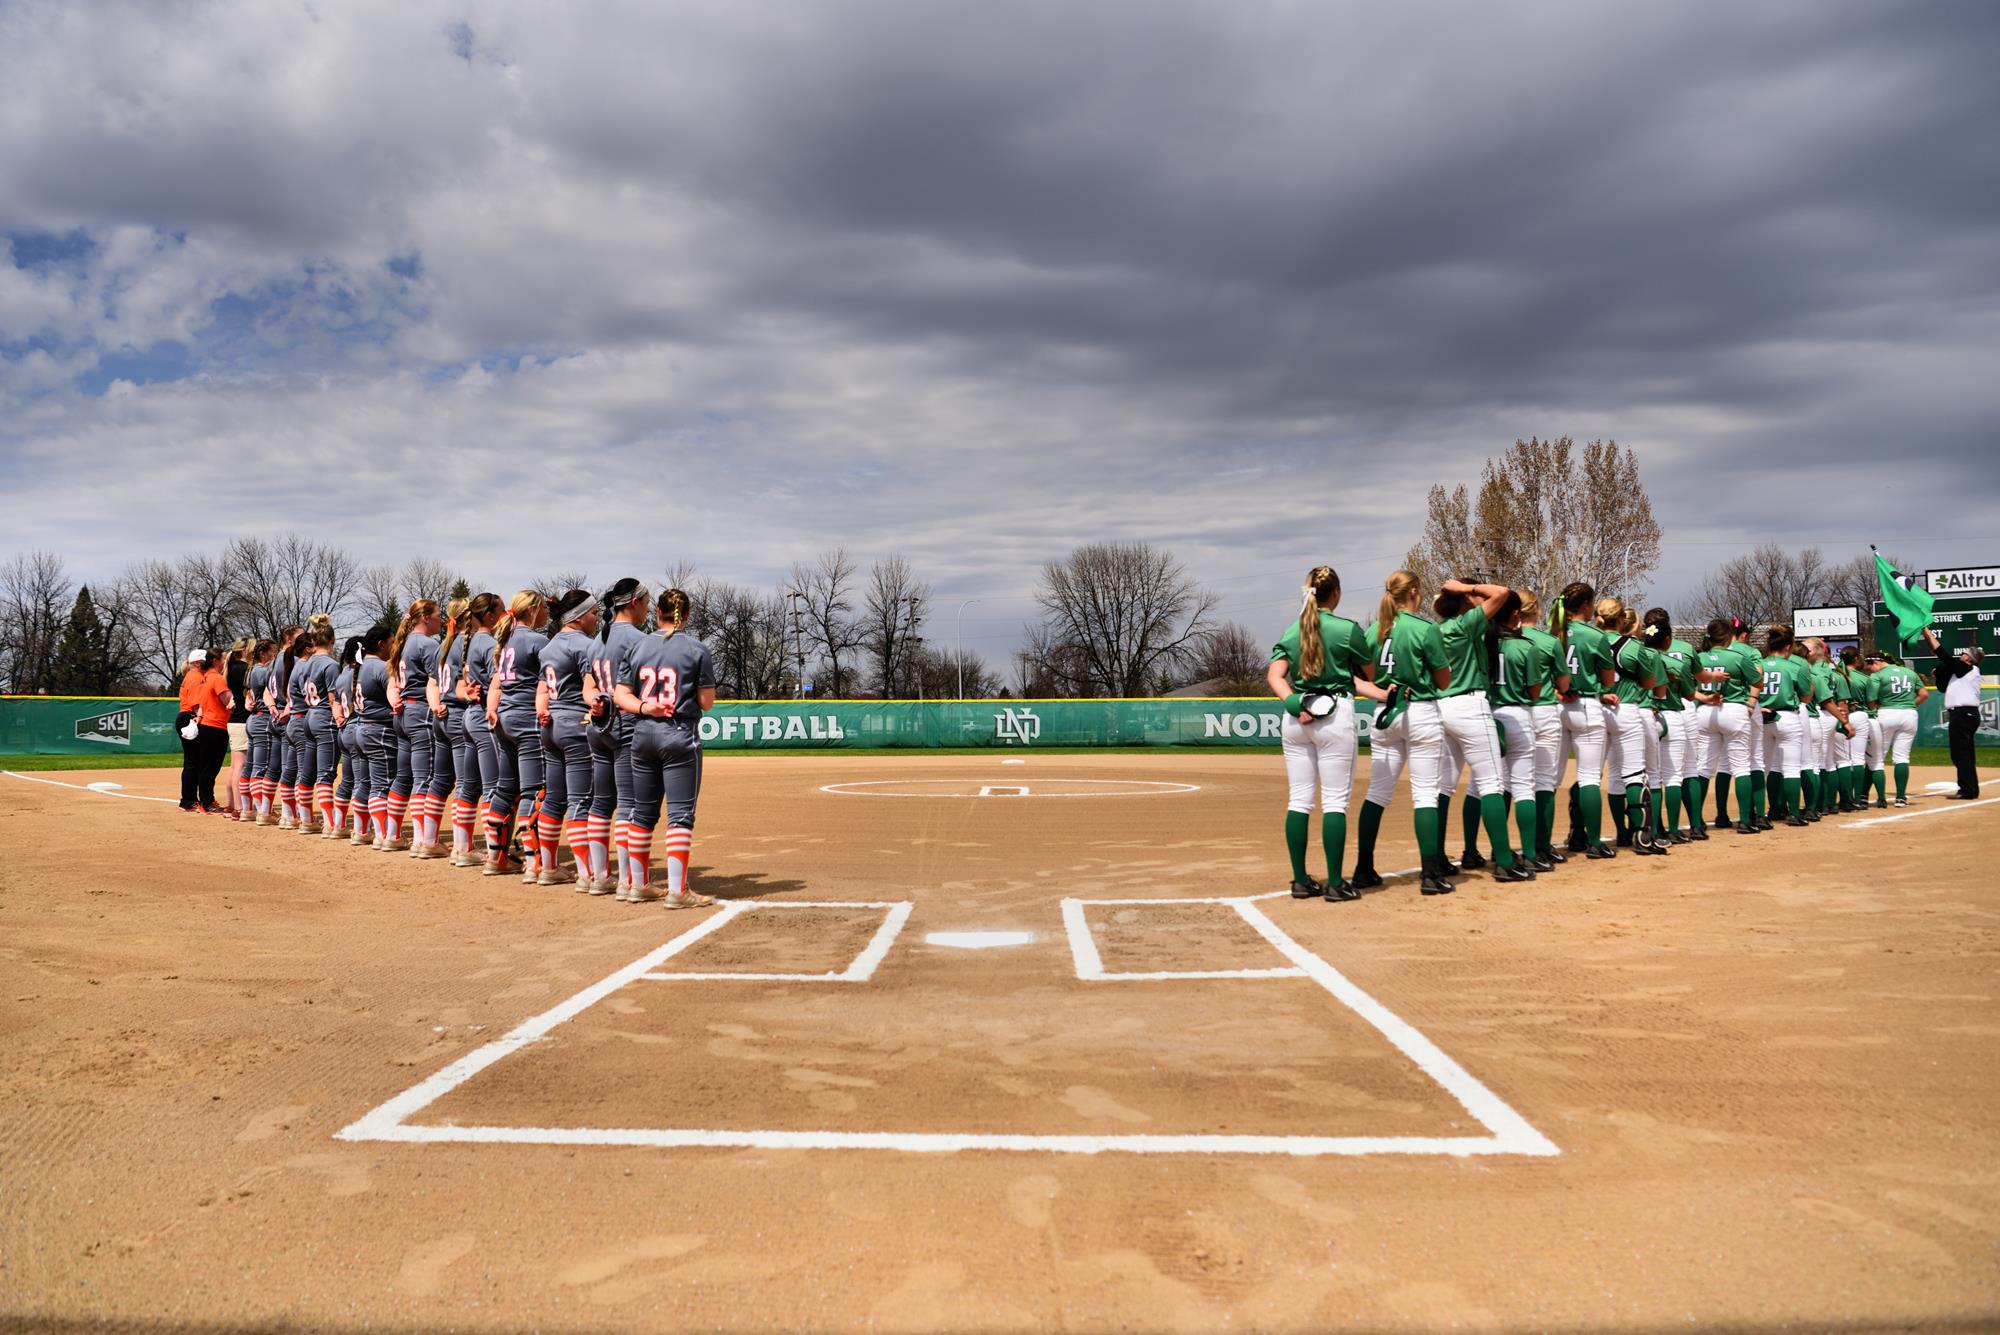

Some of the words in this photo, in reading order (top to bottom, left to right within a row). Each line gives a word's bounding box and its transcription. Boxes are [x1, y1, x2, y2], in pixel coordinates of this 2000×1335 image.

[1948, 573, 1995, 588] Altru
[1797, 617, 1856, 628] ALERUS
[1934, 614, 1963, 623] STRIKE
[1977, 612, 1995, 622] OUT
[1380, 638, 1395, 674] 4
[639, 666, 677, 707] 23
[98, 712, 127, 730] SKY
[698, 715, 844, 741] OFTBALL
[1204, 713, 1282, 738] NOR
